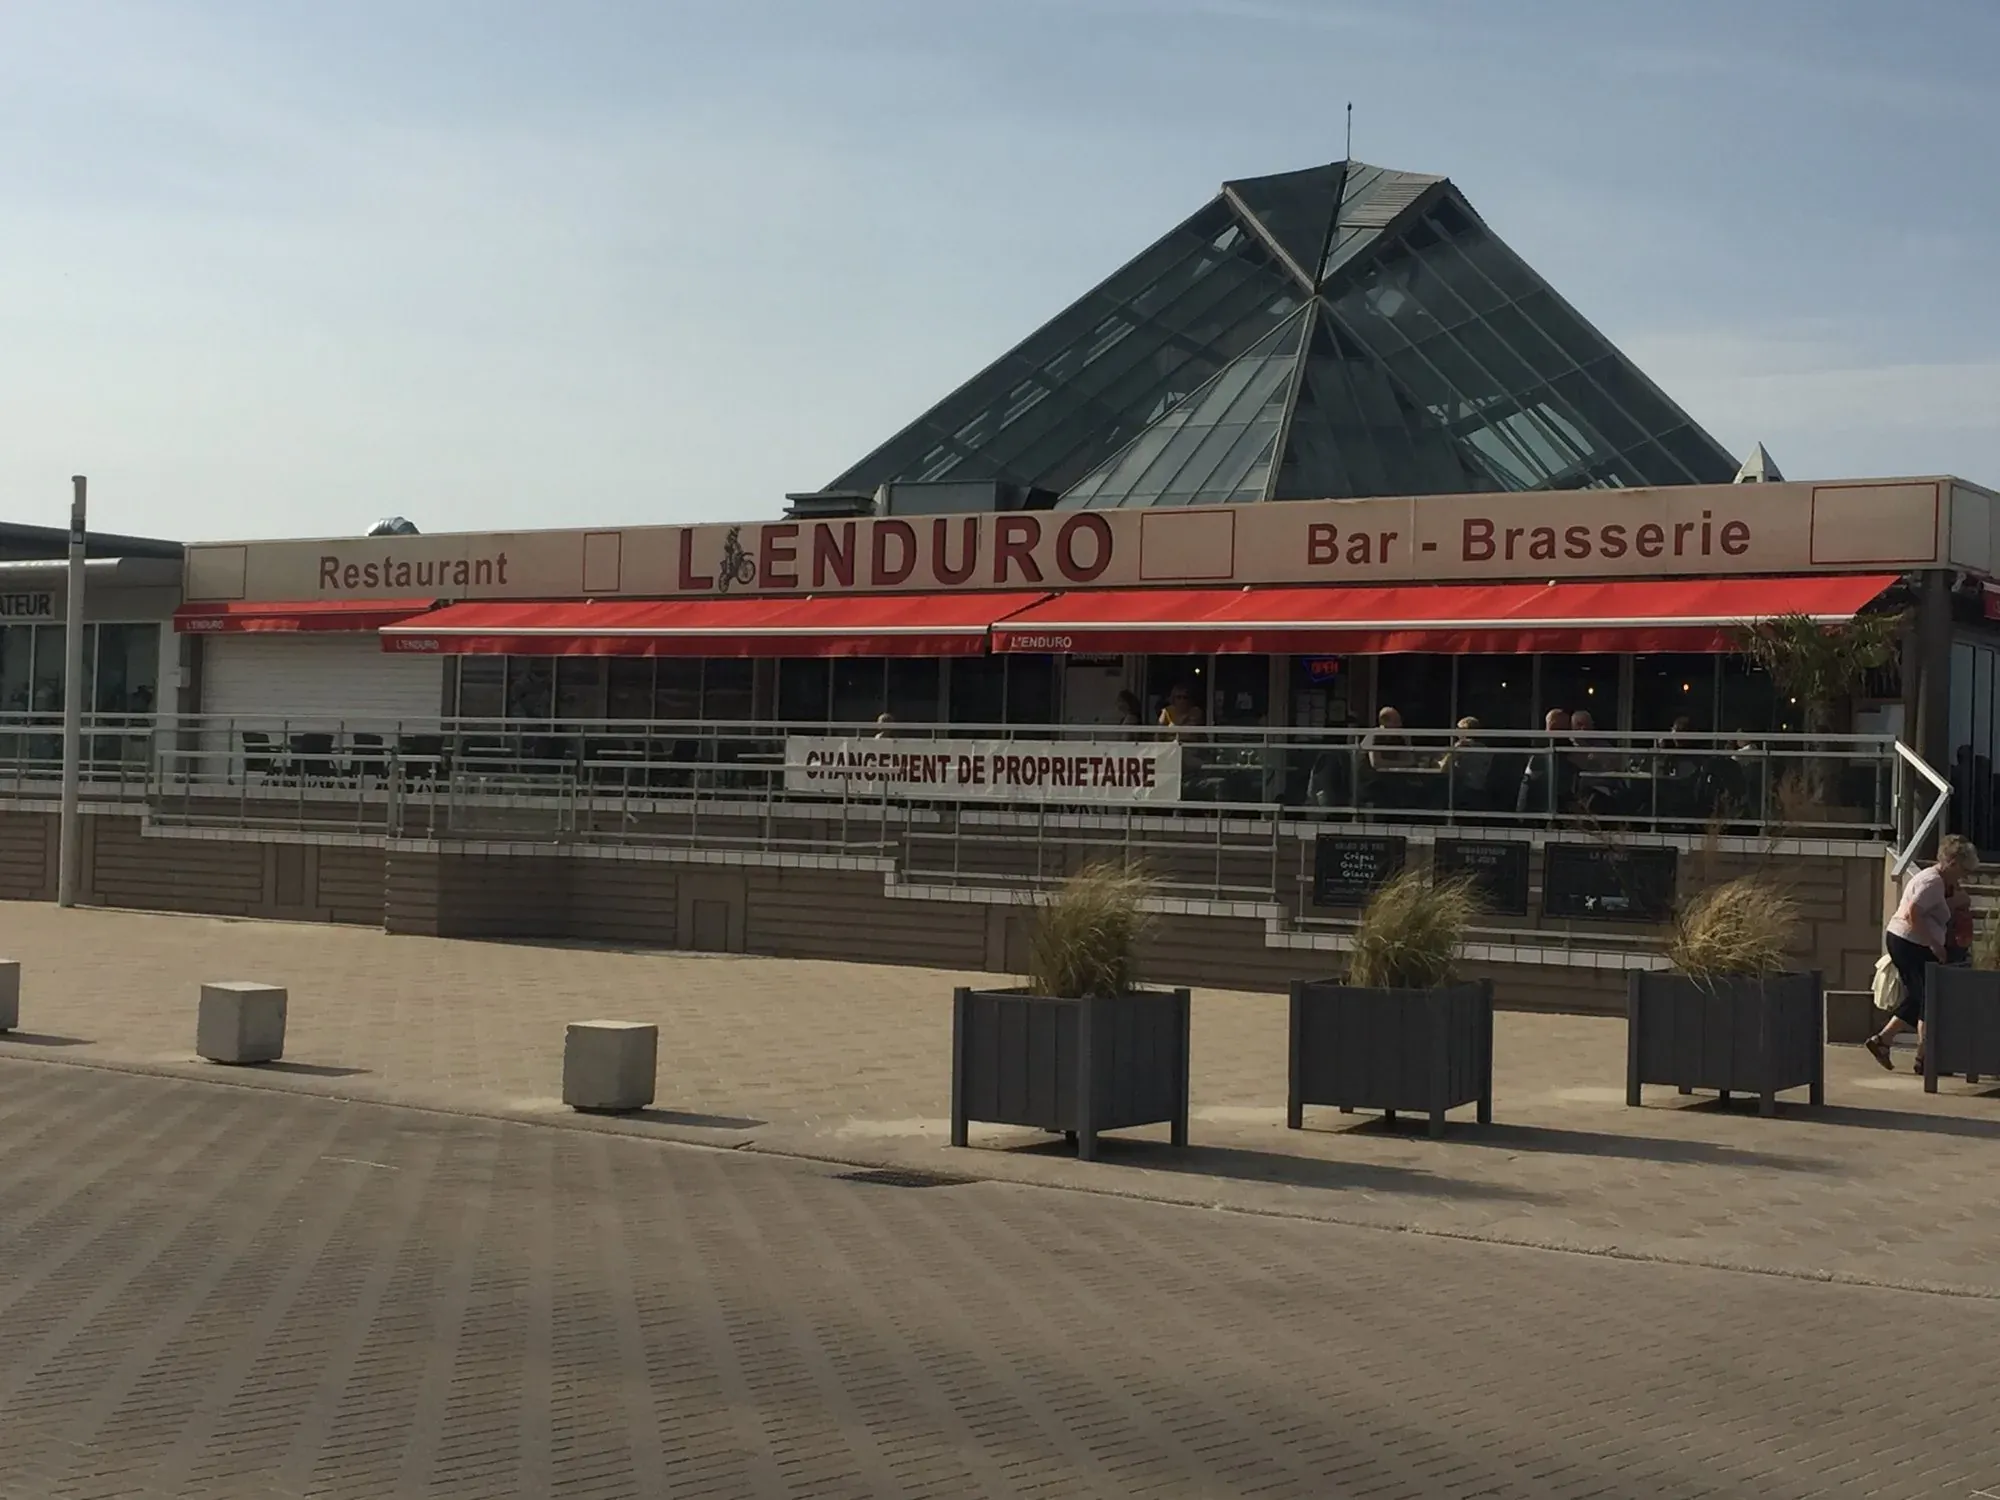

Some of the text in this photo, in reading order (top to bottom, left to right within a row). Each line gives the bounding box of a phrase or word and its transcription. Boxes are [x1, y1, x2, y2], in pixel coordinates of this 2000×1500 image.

[1307, 509, 1751, 565] Bar - Brasserie
[319, 552, 508, 590] Restaurant
[1010, 635, 1073, 648] L'ENDURO
[806, 750, 1157, 789] CHANGEMENT DE PROPRIETAIRE
